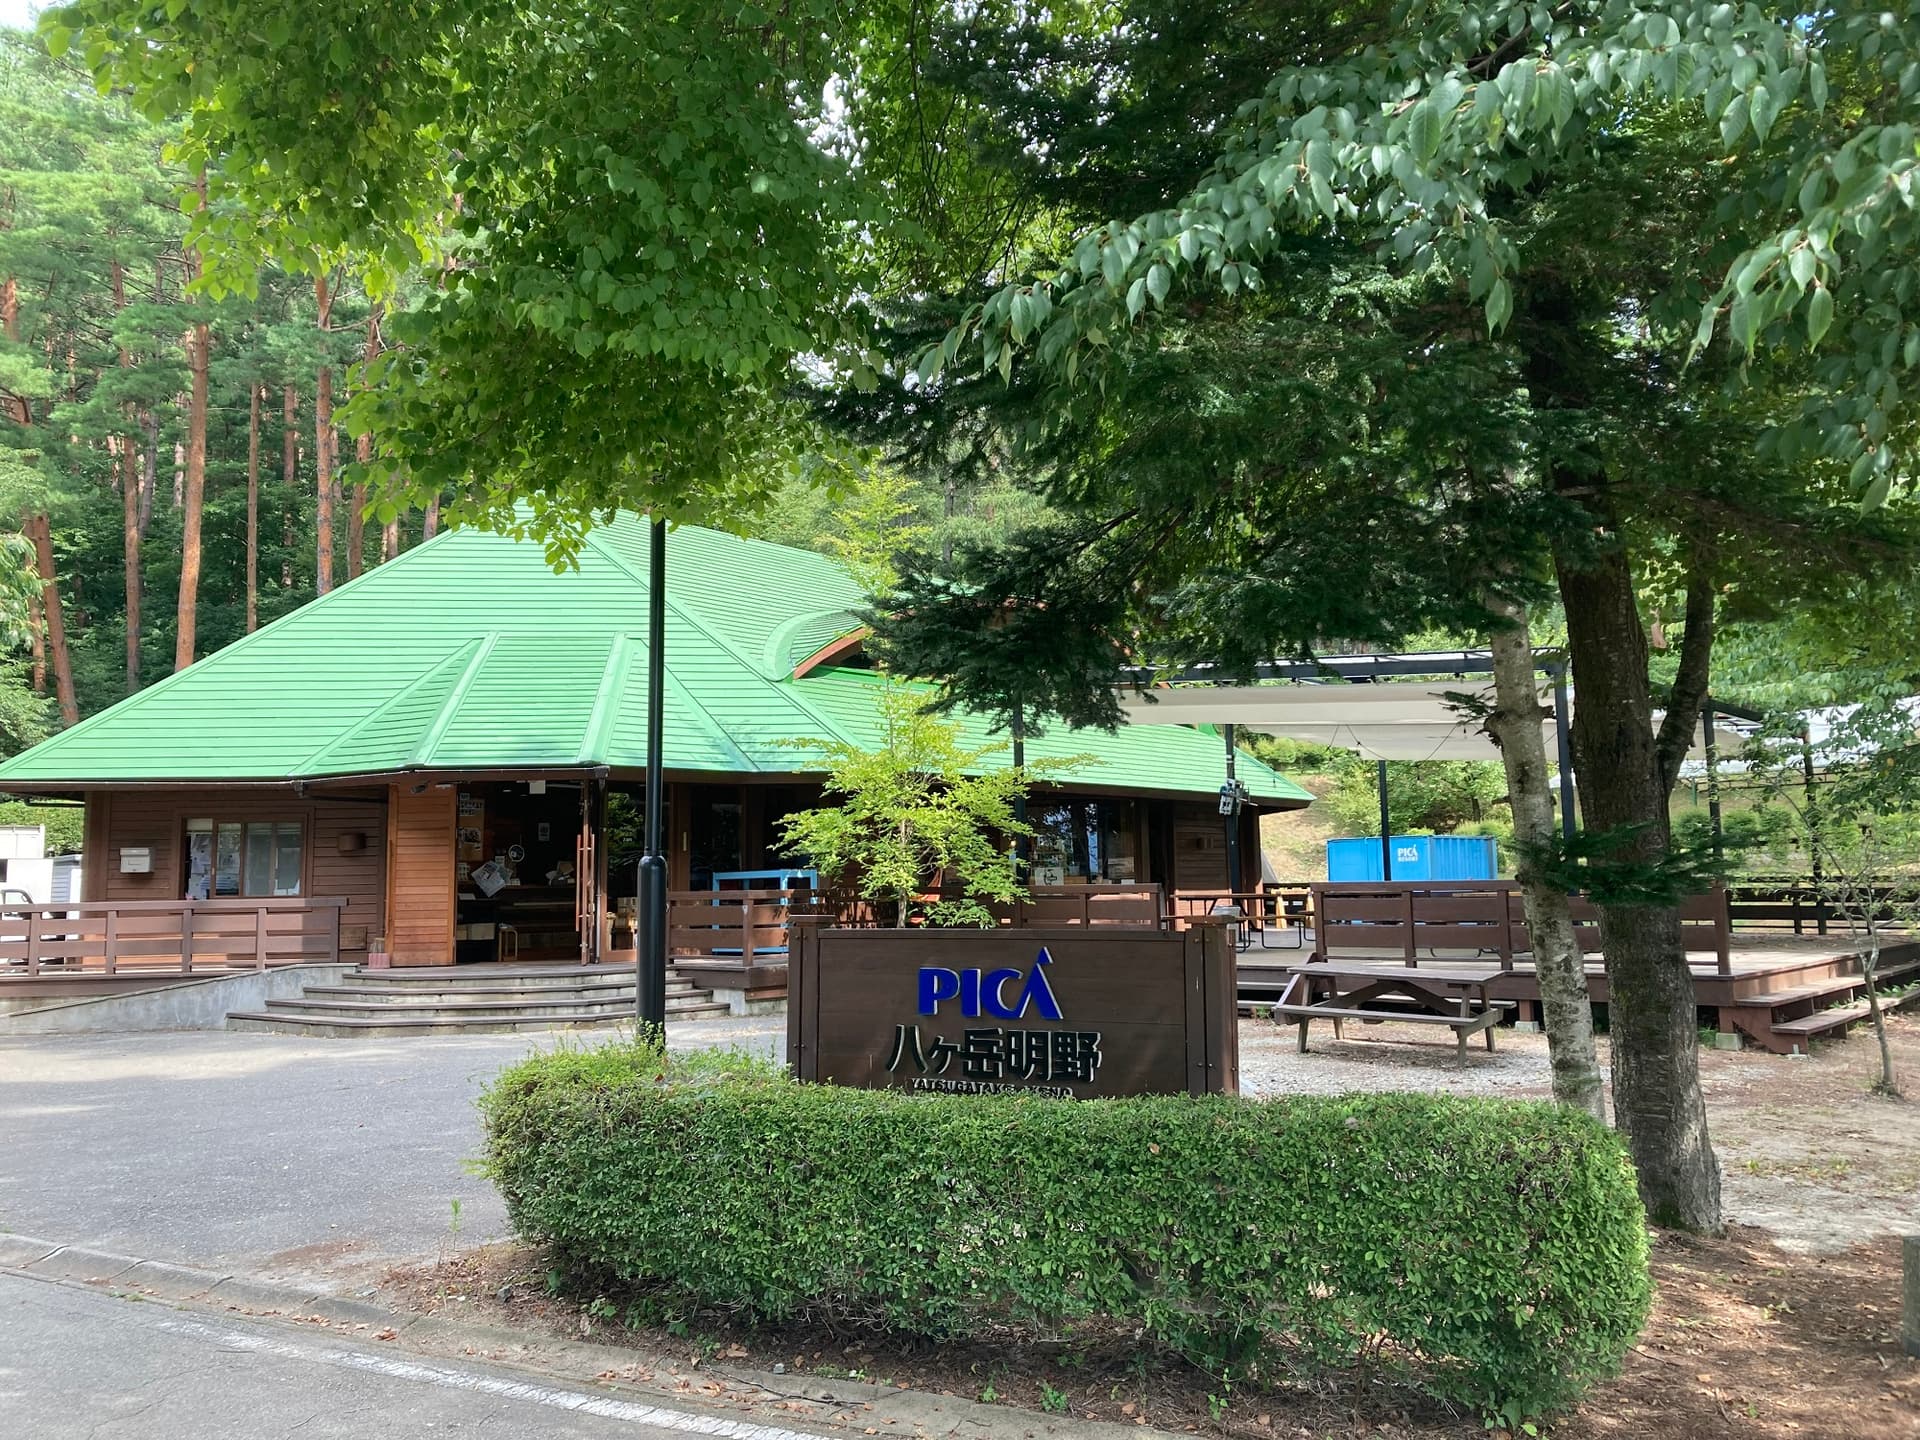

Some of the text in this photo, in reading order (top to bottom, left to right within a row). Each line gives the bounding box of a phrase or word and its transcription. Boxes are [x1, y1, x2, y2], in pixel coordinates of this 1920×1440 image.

[1397, 844, 1419, 857] PICA
[918, 946, 1064, 1020] PICA
[886, 1024, 1103, 1083] 八ヶ岳明野
[911, 1078, 1016, 1096] YATSUGATAKE
